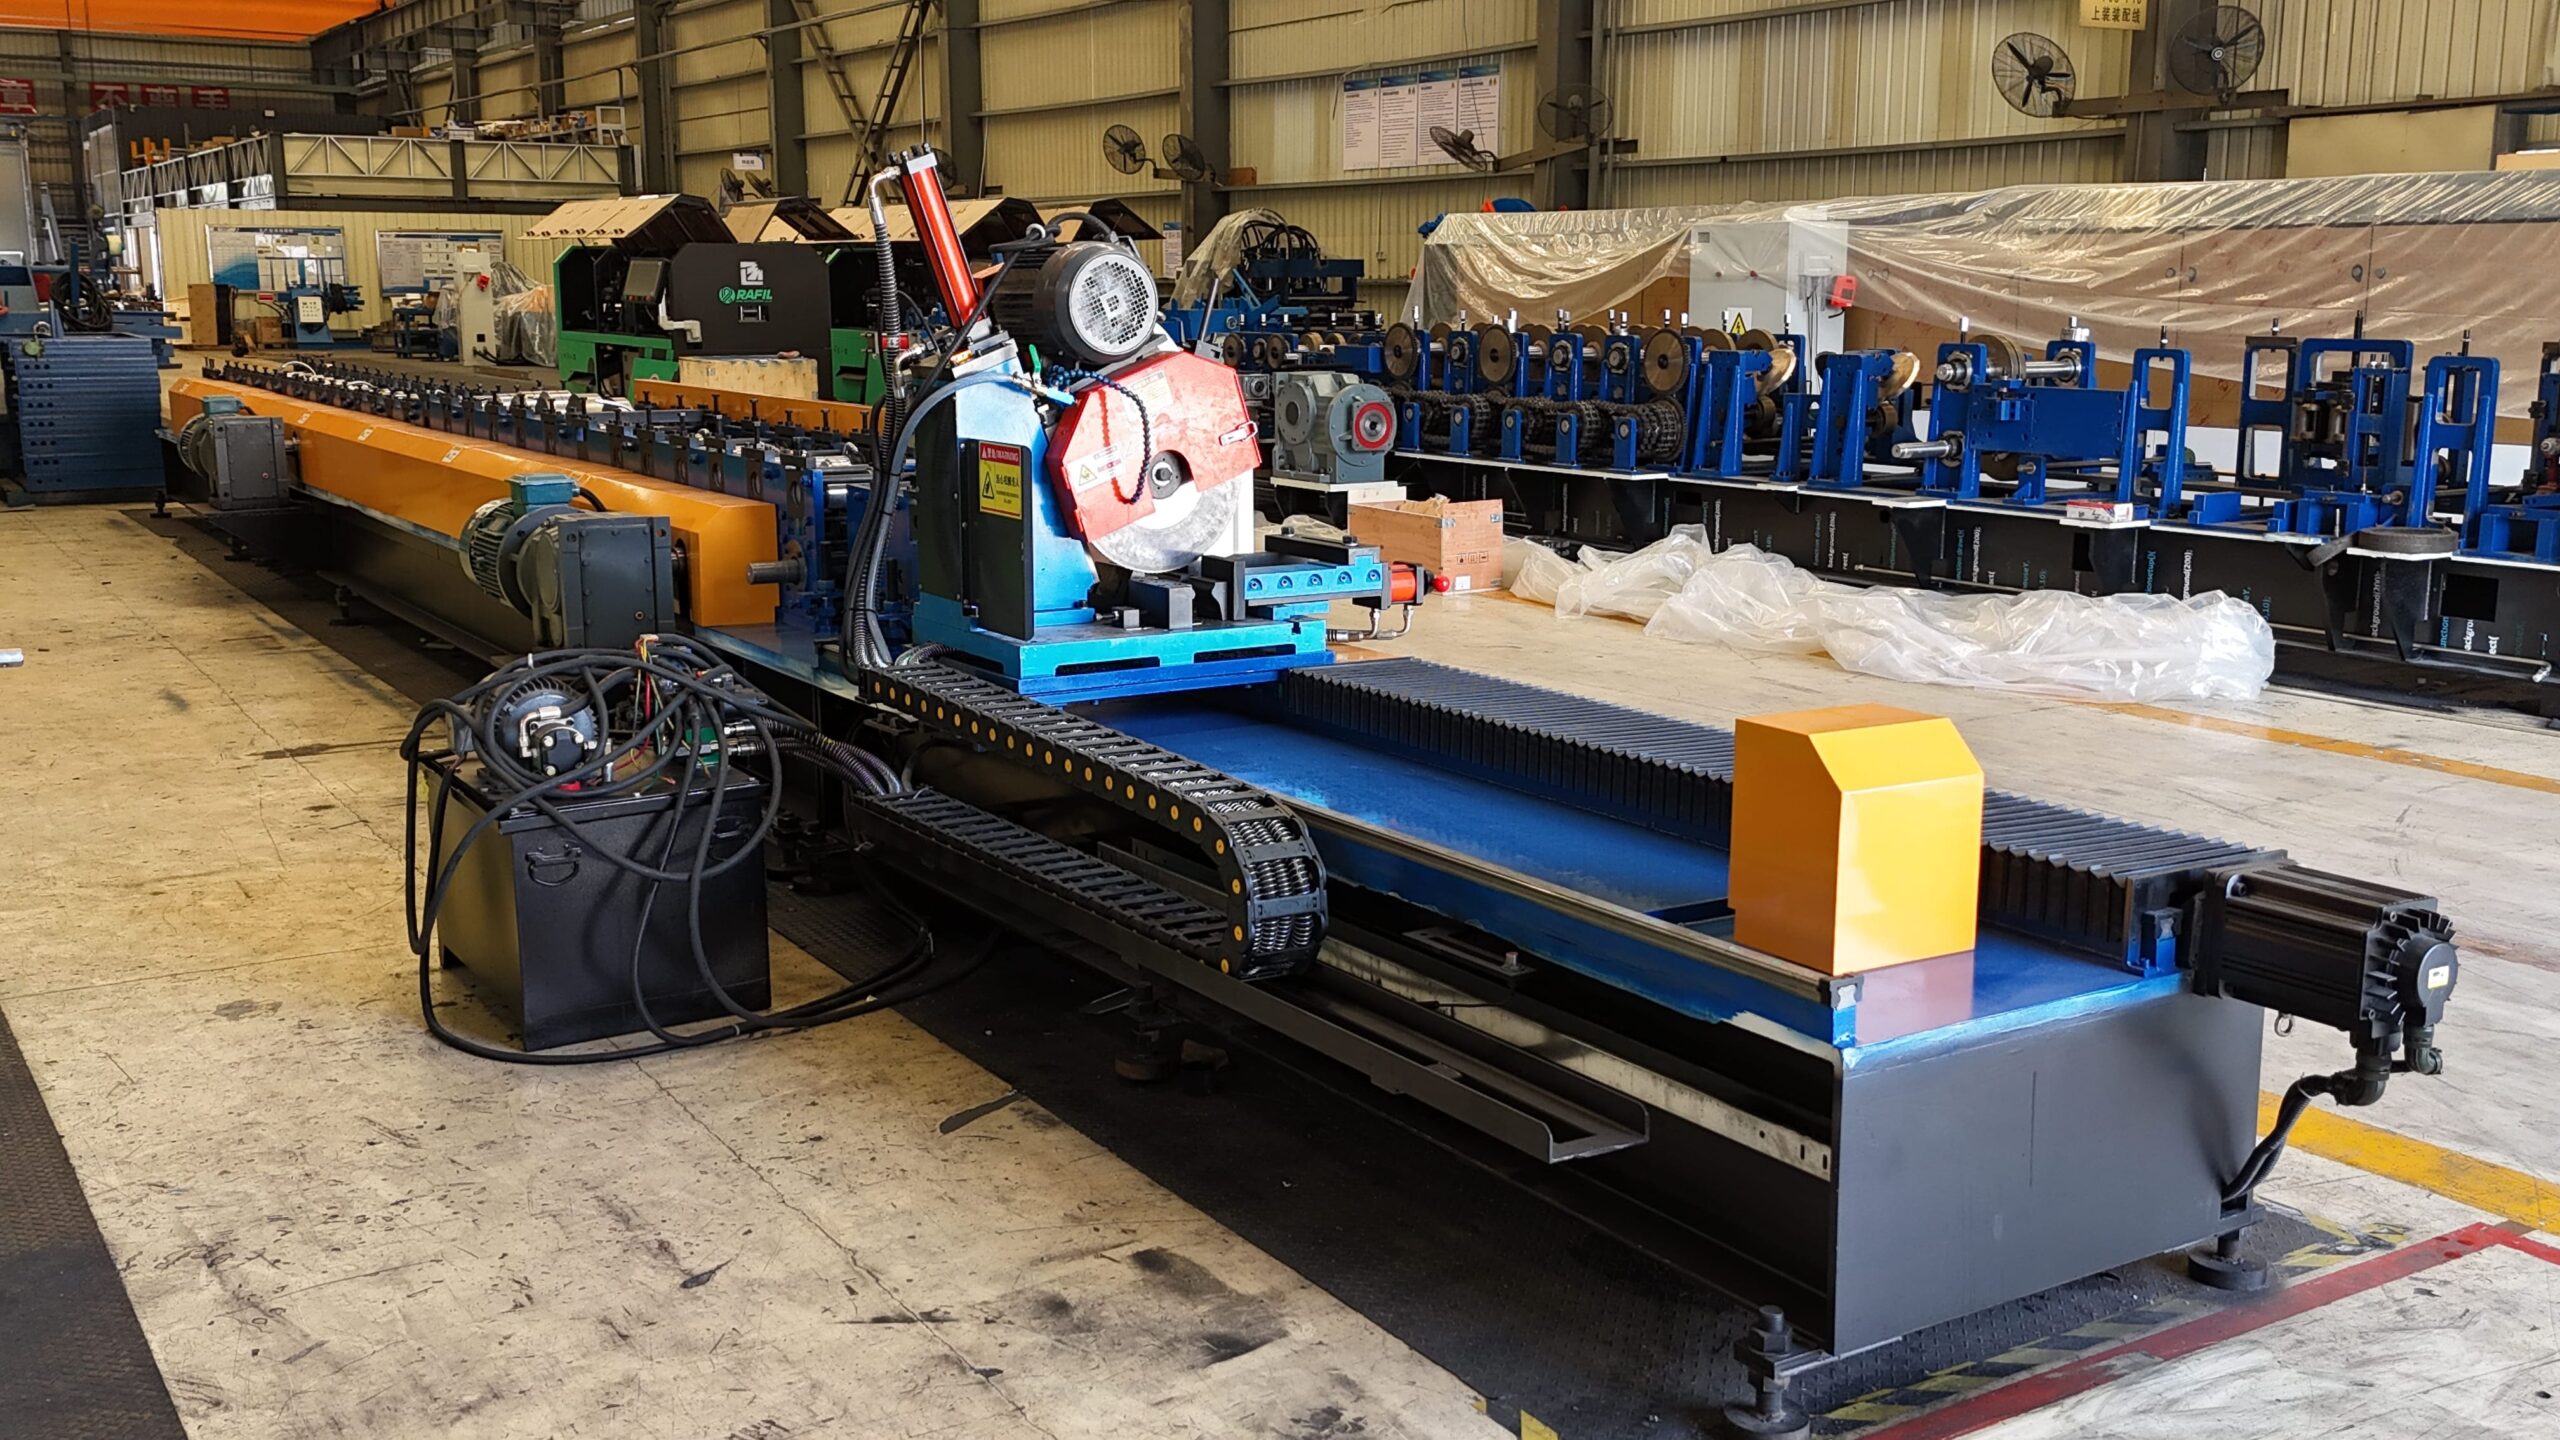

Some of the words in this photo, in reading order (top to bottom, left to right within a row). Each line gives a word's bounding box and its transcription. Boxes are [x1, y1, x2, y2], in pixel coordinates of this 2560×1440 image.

[736, 288, 773, 300] RAFIL
[1972, 526, 1982, 583] ackground(200);
[2487, 634, 2501, 656] ect(
